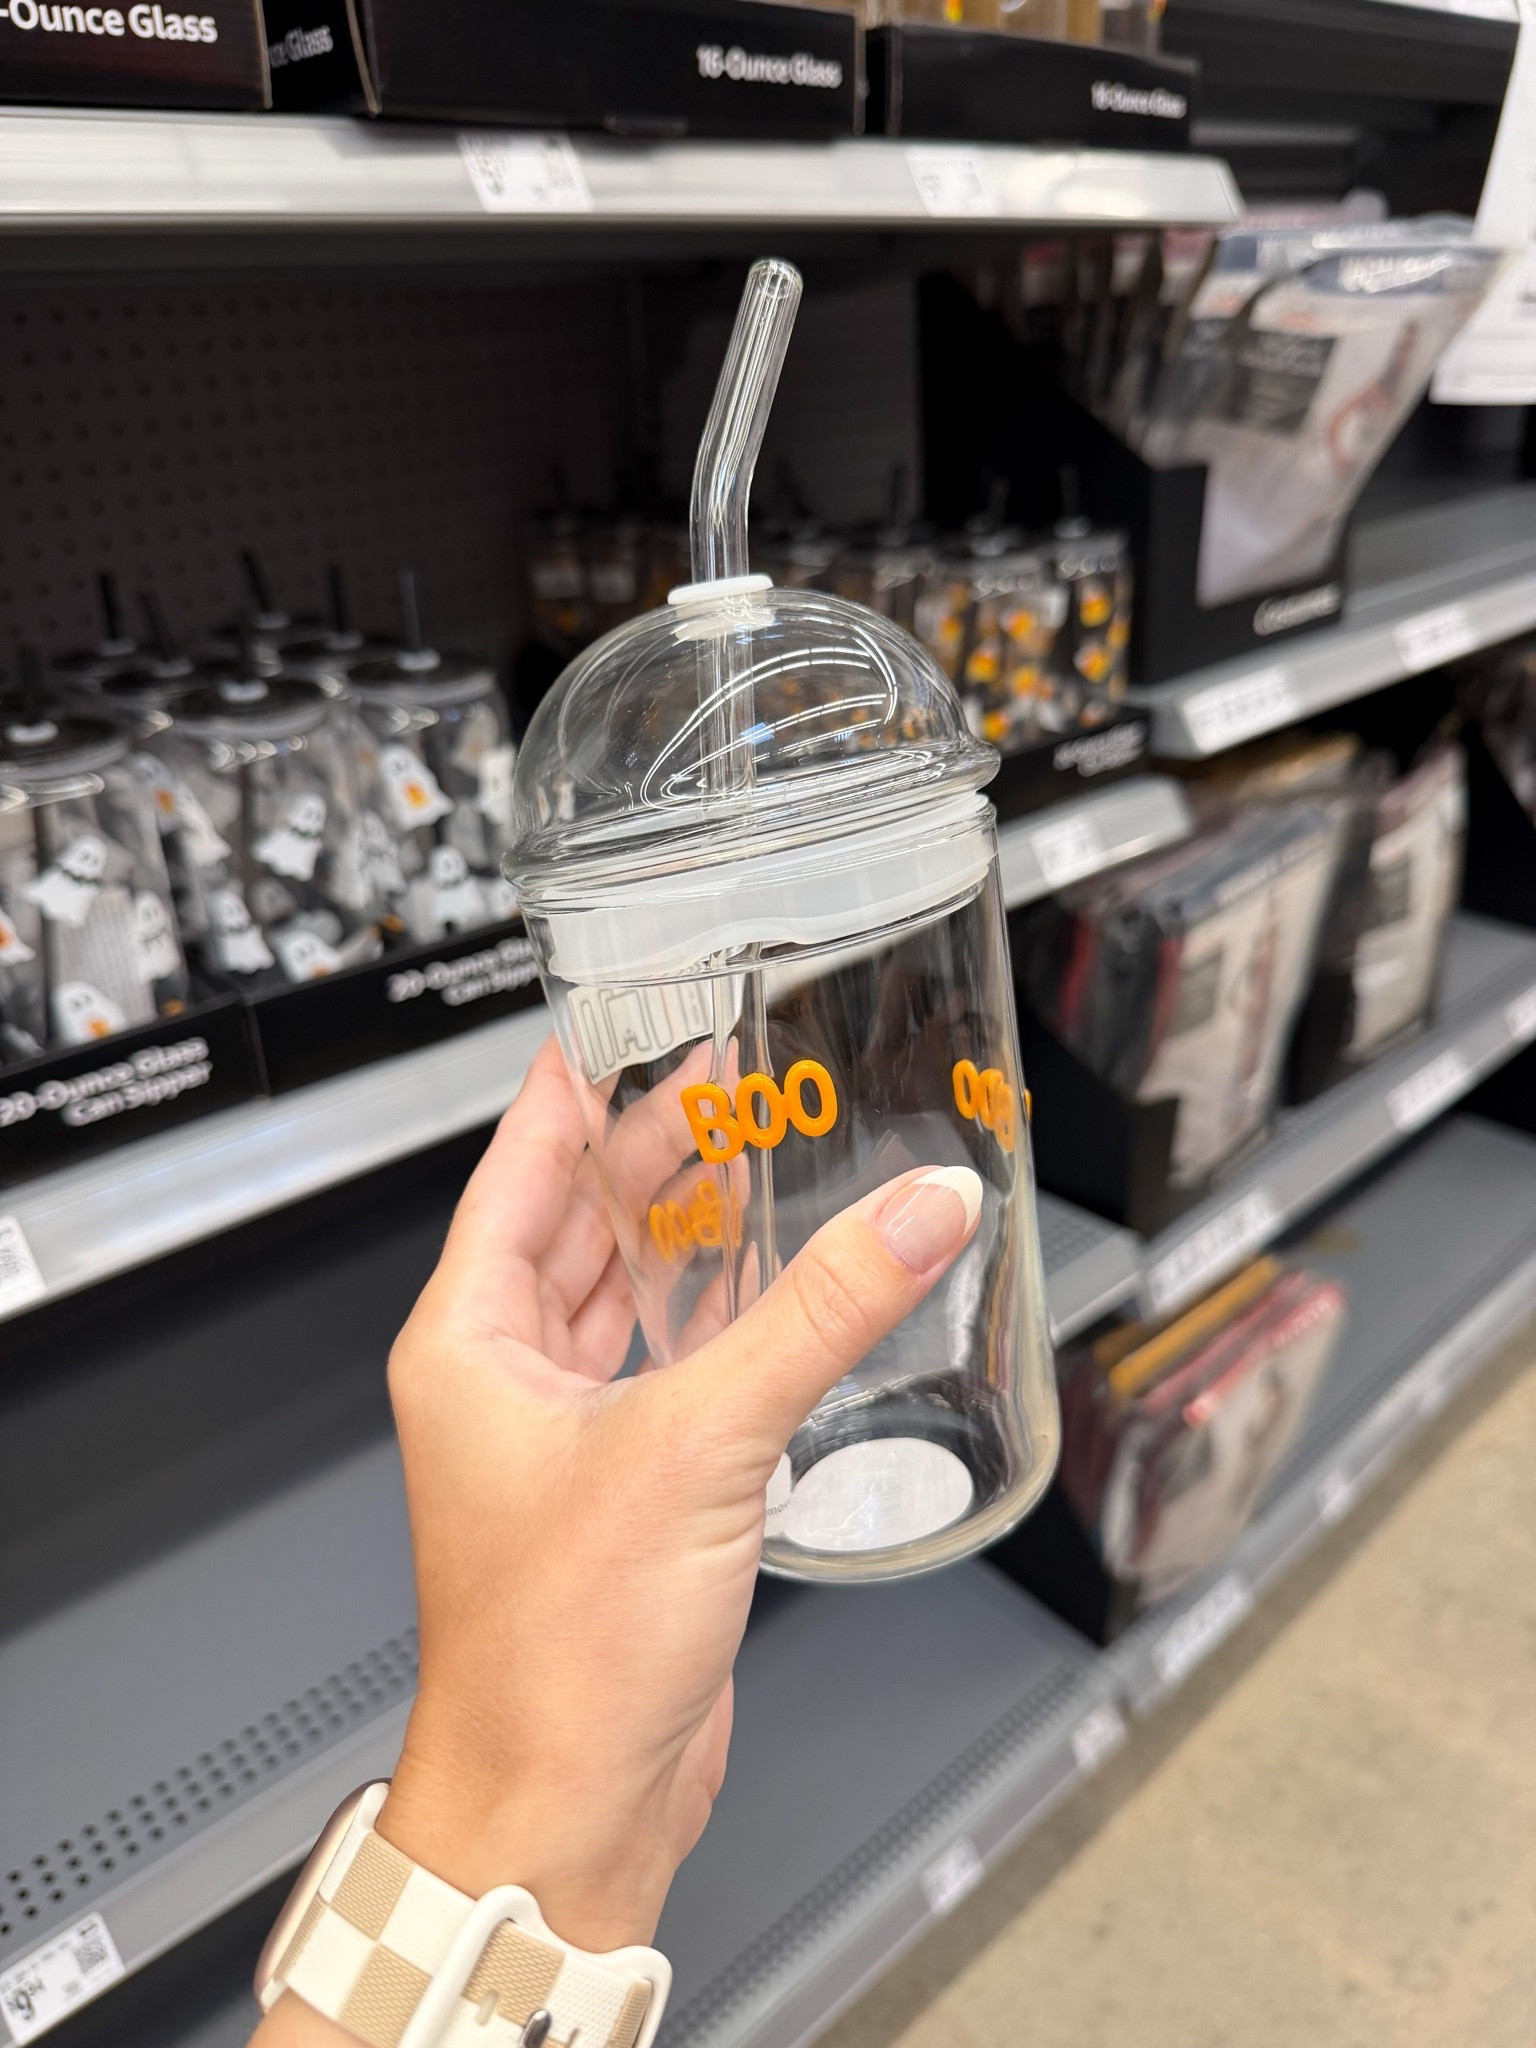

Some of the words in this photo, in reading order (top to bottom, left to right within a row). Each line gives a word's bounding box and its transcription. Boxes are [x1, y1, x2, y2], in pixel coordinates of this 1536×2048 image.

[128, 4, 218, 43] Glass
[128, 1037, 209, 1080] Glass
[680, 1059, 838, 1164] BOO
